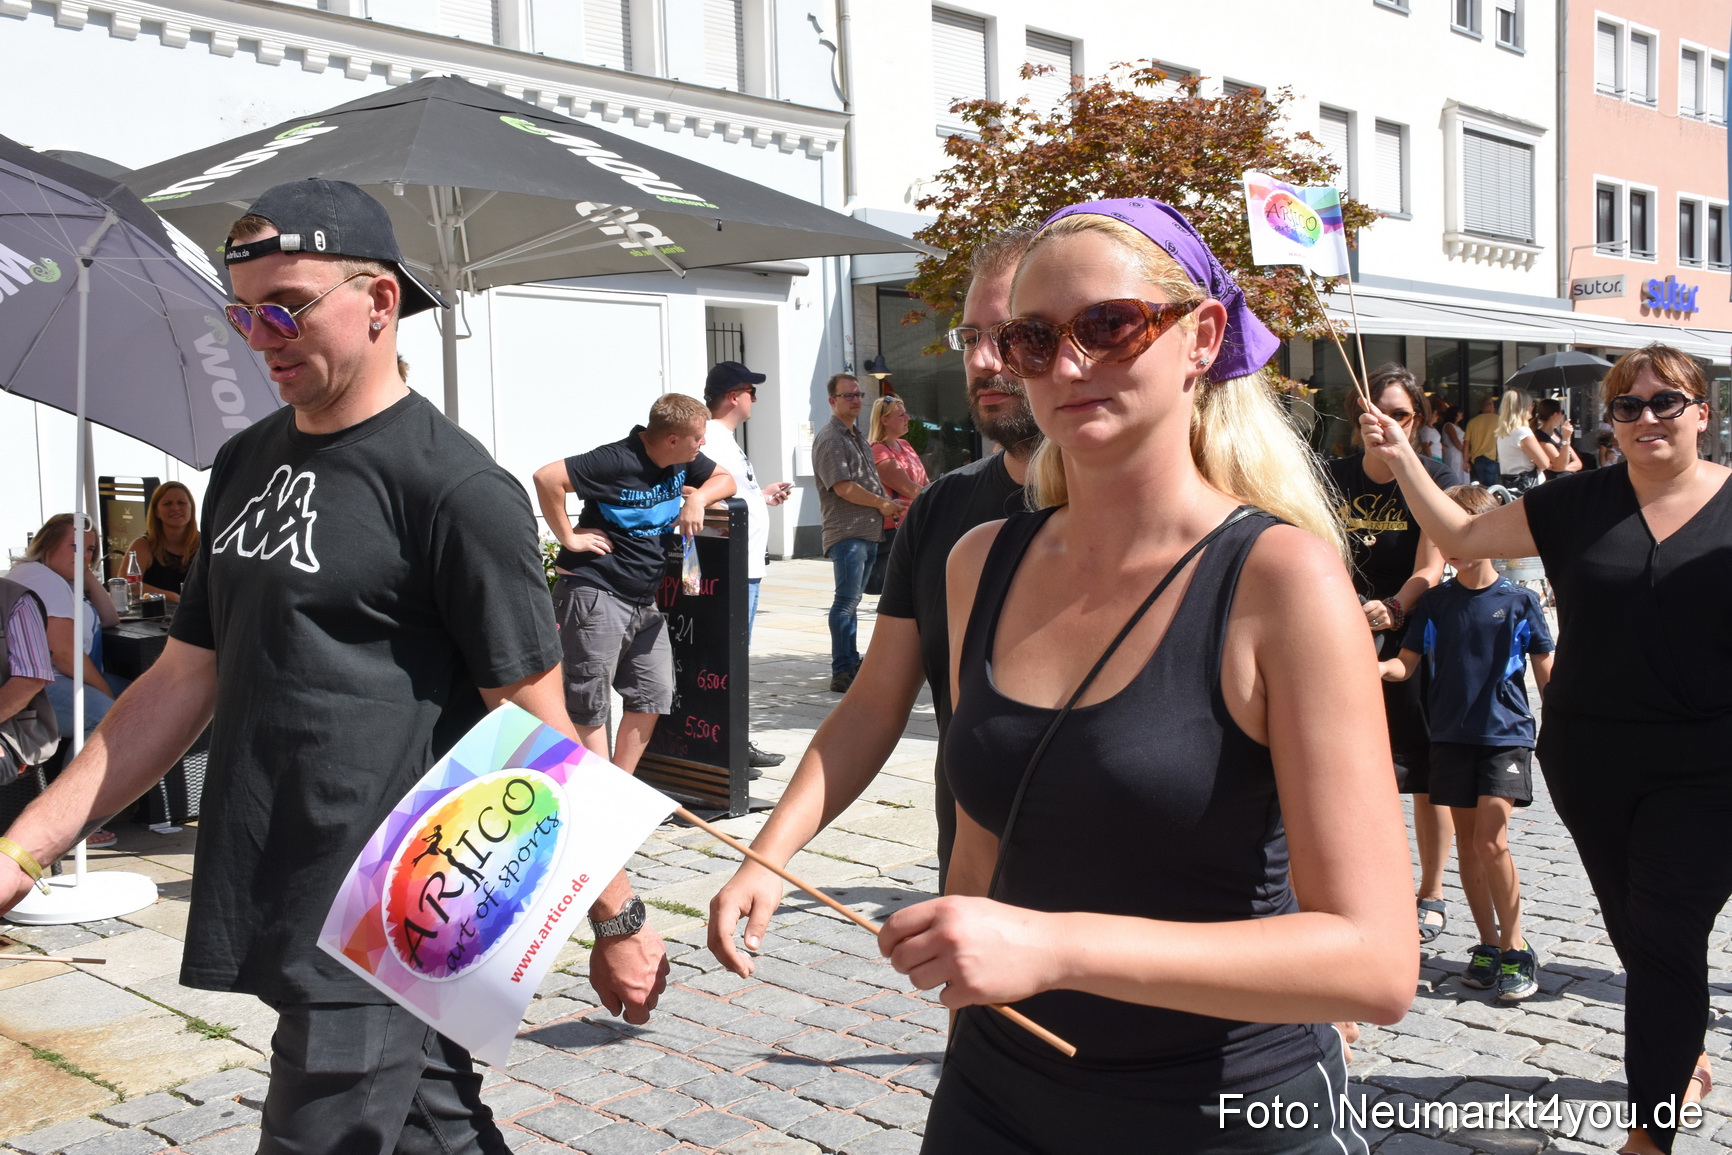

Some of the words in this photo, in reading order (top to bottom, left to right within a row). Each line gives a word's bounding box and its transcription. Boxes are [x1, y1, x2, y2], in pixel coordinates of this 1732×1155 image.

[697, 669, 728, 691] 6,50€
[684, 715, 721, 743] 5,50€
[446, 917, 476, 973] art
[476, 881, 501, 919] of
[498, 810, 560, 889] sports
[510, 871, 591, 985] www.artico.de
